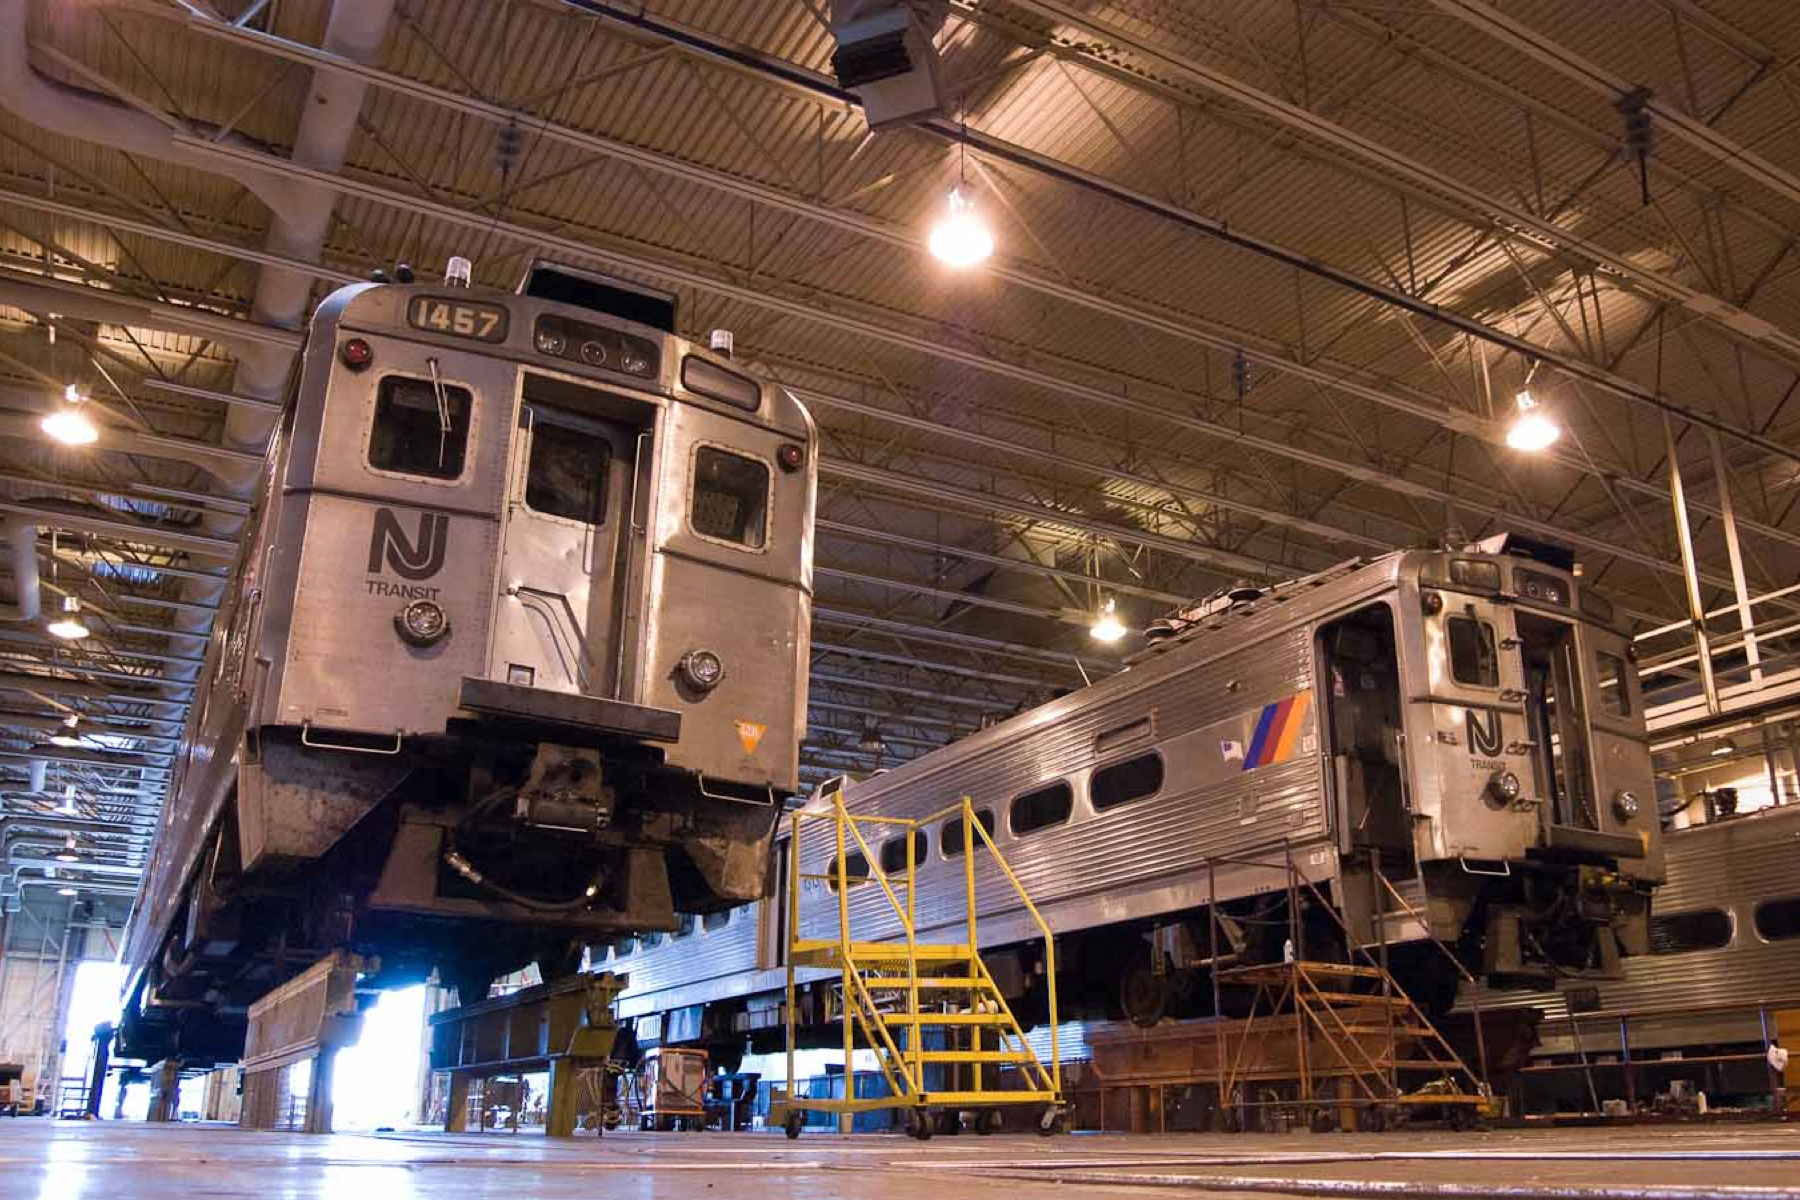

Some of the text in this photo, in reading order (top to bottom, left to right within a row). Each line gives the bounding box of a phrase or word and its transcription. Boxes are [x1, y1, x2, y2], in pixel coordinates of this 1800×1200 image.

[417, 300, 500, 337] 1457
[367, 507, 450, 580] NJ
[365, 580, 442, 601] TRANSIT
[1465, 707, 1503, 757] NJ
